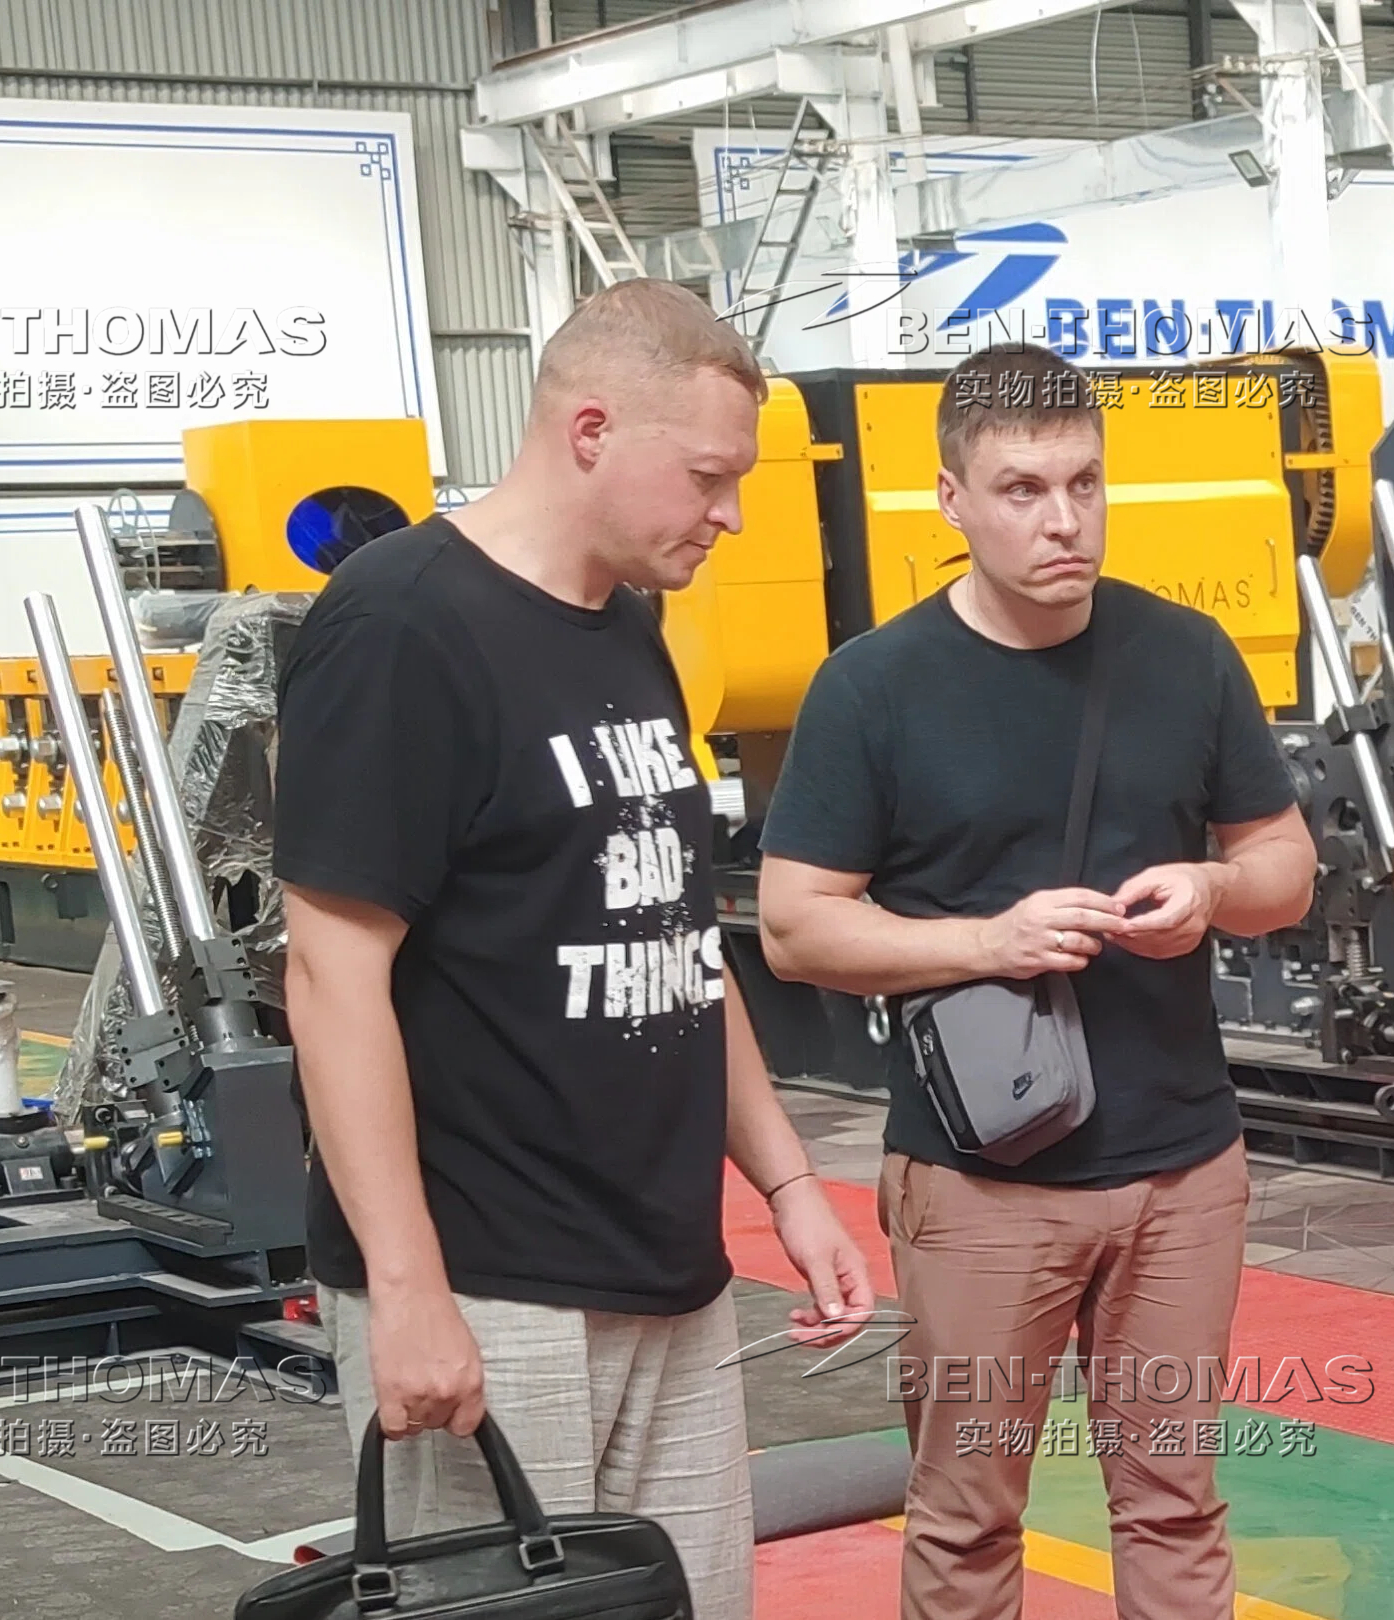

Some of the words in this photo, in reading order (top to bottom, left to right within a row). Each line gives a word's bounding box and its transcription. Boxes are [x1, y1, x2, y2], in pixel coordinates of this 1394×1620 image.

[549, 733, 593, 807] I
[594, 718, 698, 797] LIKE
[606, 826, 684, 910] BAD
